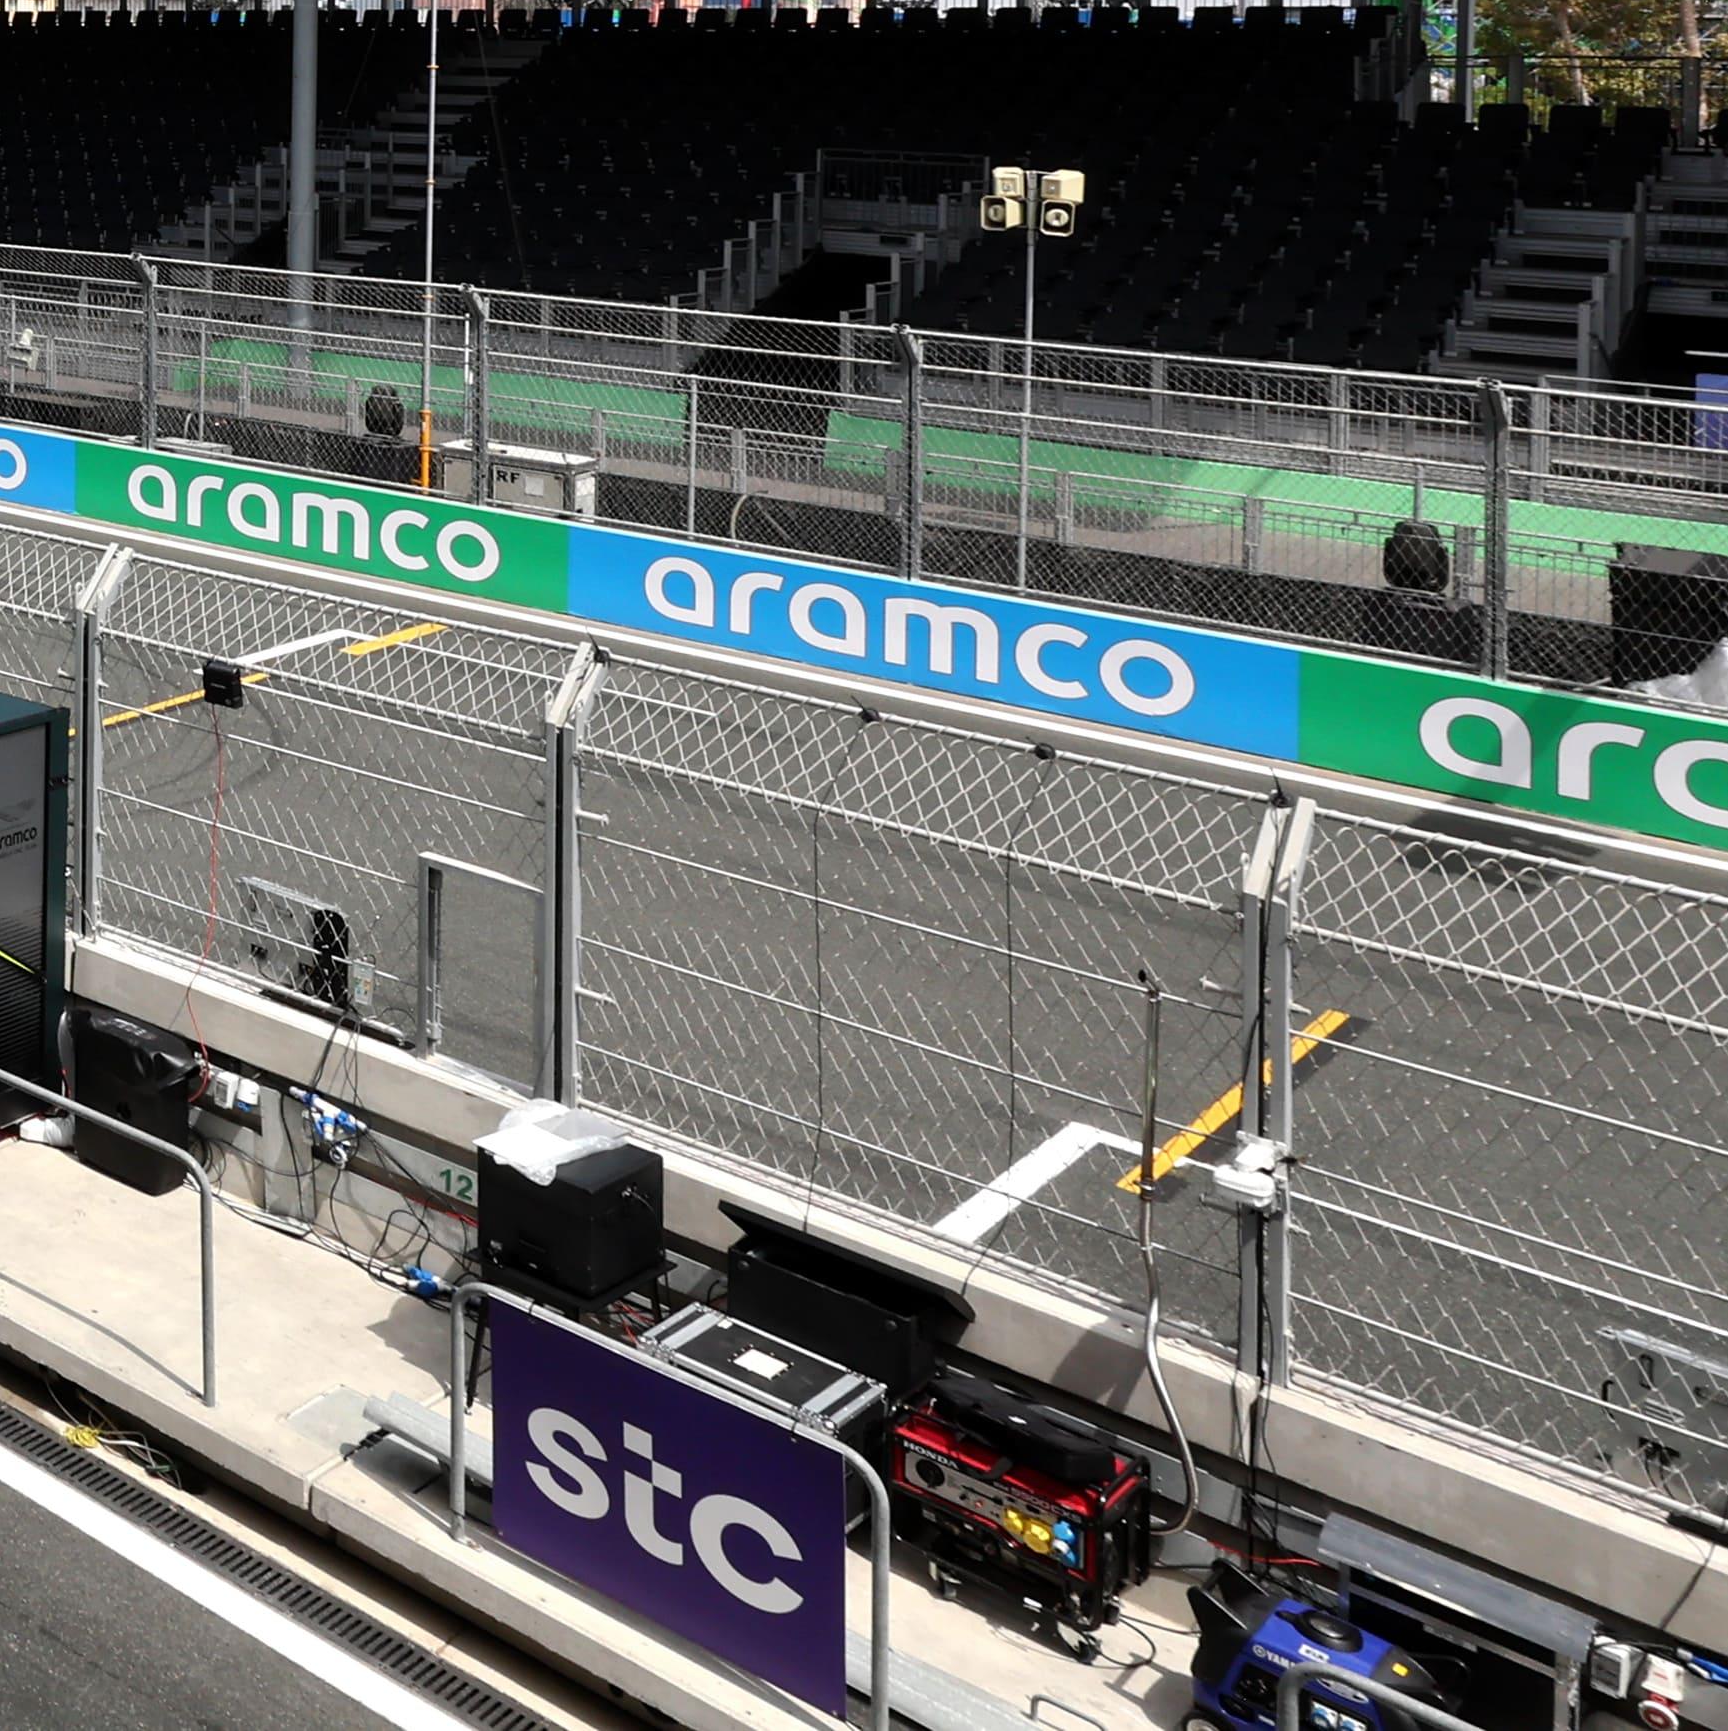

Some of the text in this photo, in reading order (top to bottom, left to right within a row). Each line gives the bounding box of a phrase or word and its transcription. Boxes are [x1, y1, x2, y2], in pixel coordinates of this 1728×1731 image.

[496, 470, 520, 484] RF
[127, 463, 501, 582] aramco
[643, 555, 1196, 717] aramco
[439, 1168, 473, 1202] 12
[903, 1440, 960, 1470] HONDA
[523, 1406, 805, 1615] stc
